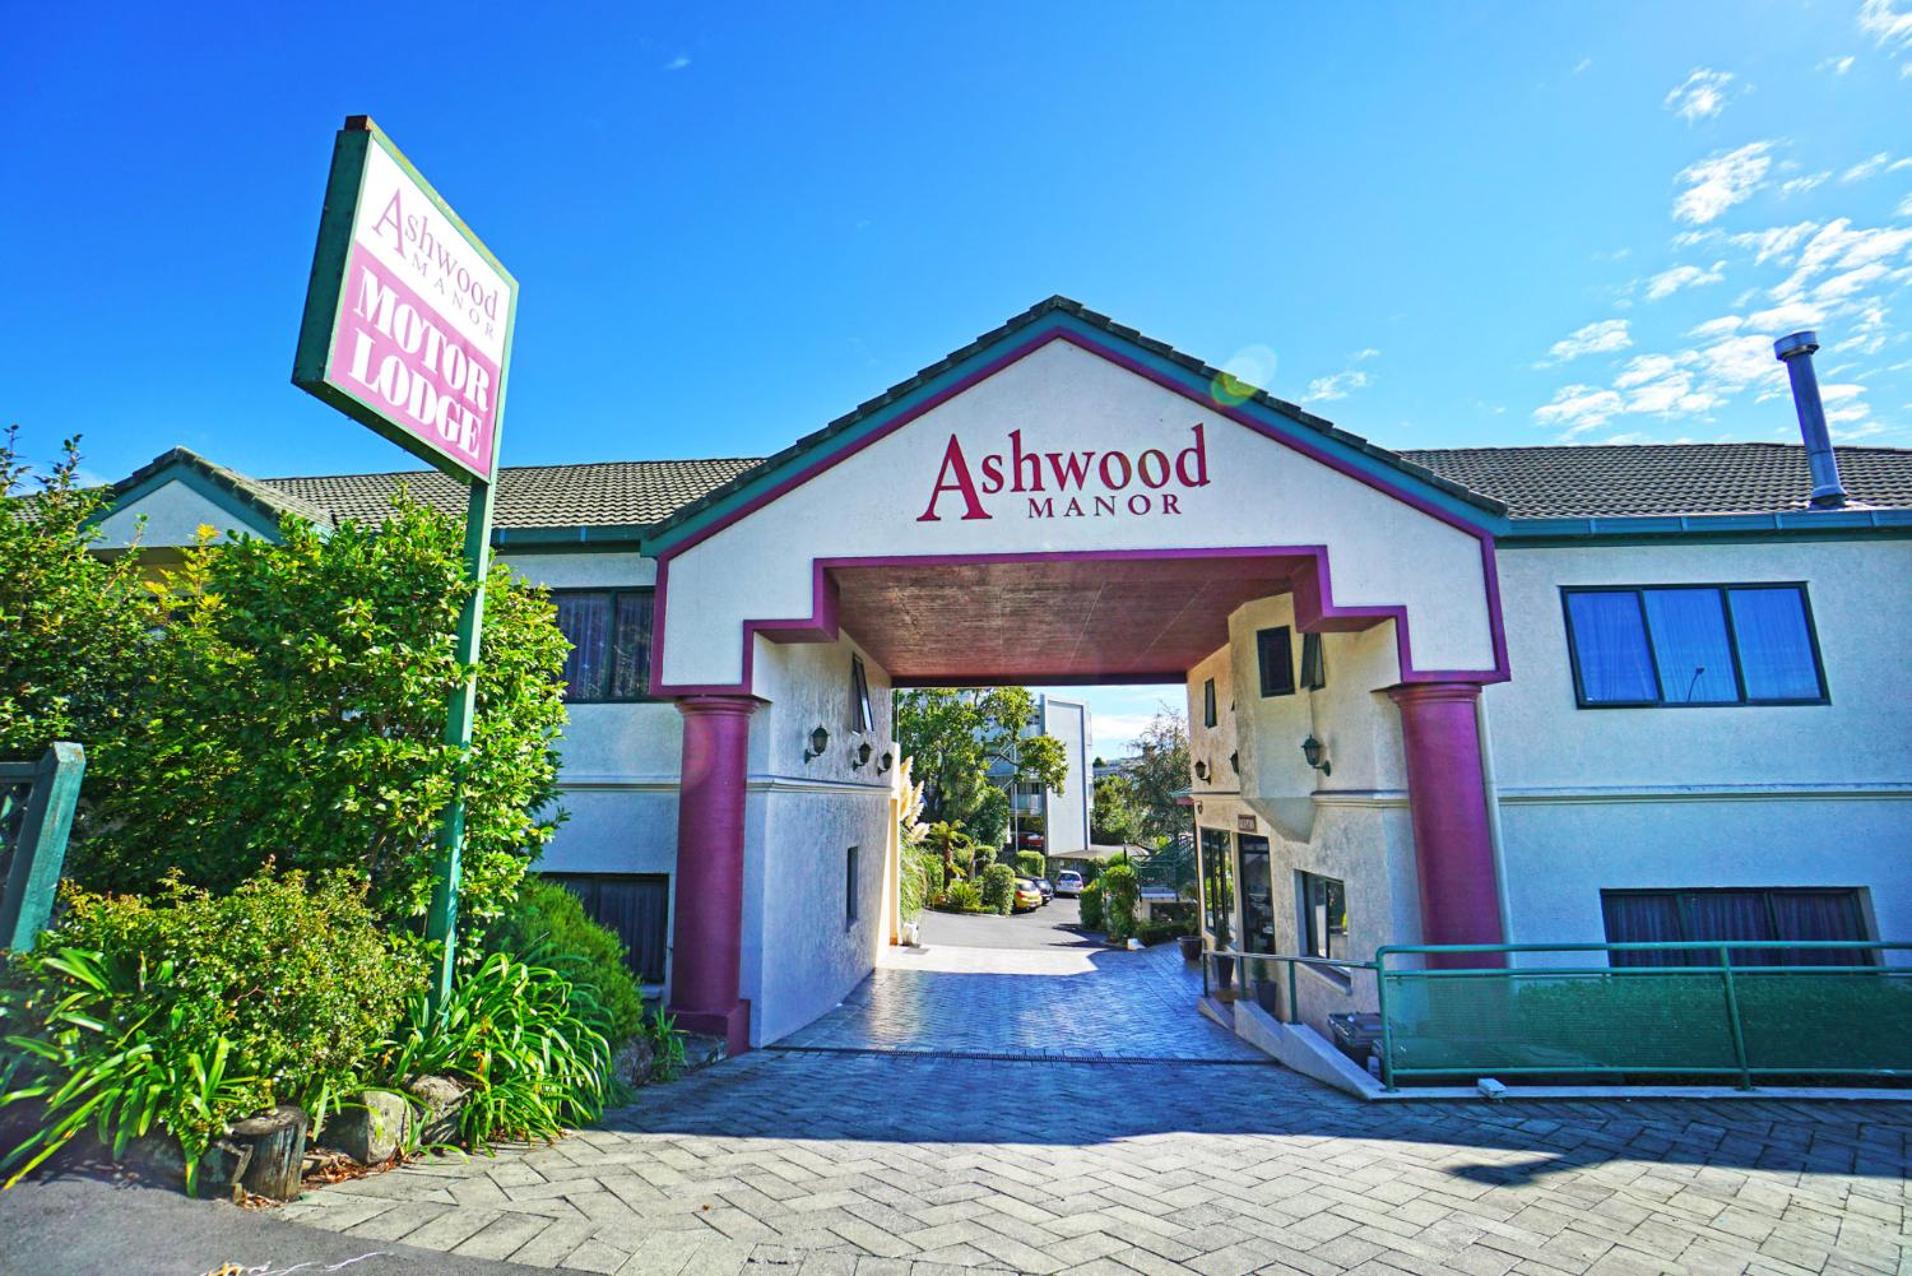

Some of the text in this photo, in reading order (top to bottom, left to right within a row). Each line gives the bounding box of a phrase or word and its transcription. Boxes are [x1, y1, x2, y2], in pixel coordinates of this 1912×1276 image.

[371, 187, 498, 320] Ashwood
[411, 256, 495, 341] MANOR
[348, 328, 483, 459] LODGE
[353, 265, 489, 413] MOTOR
[916, 422, 1210, 522] Ashwood
[1028, 494, 1181, 518] MANOR
